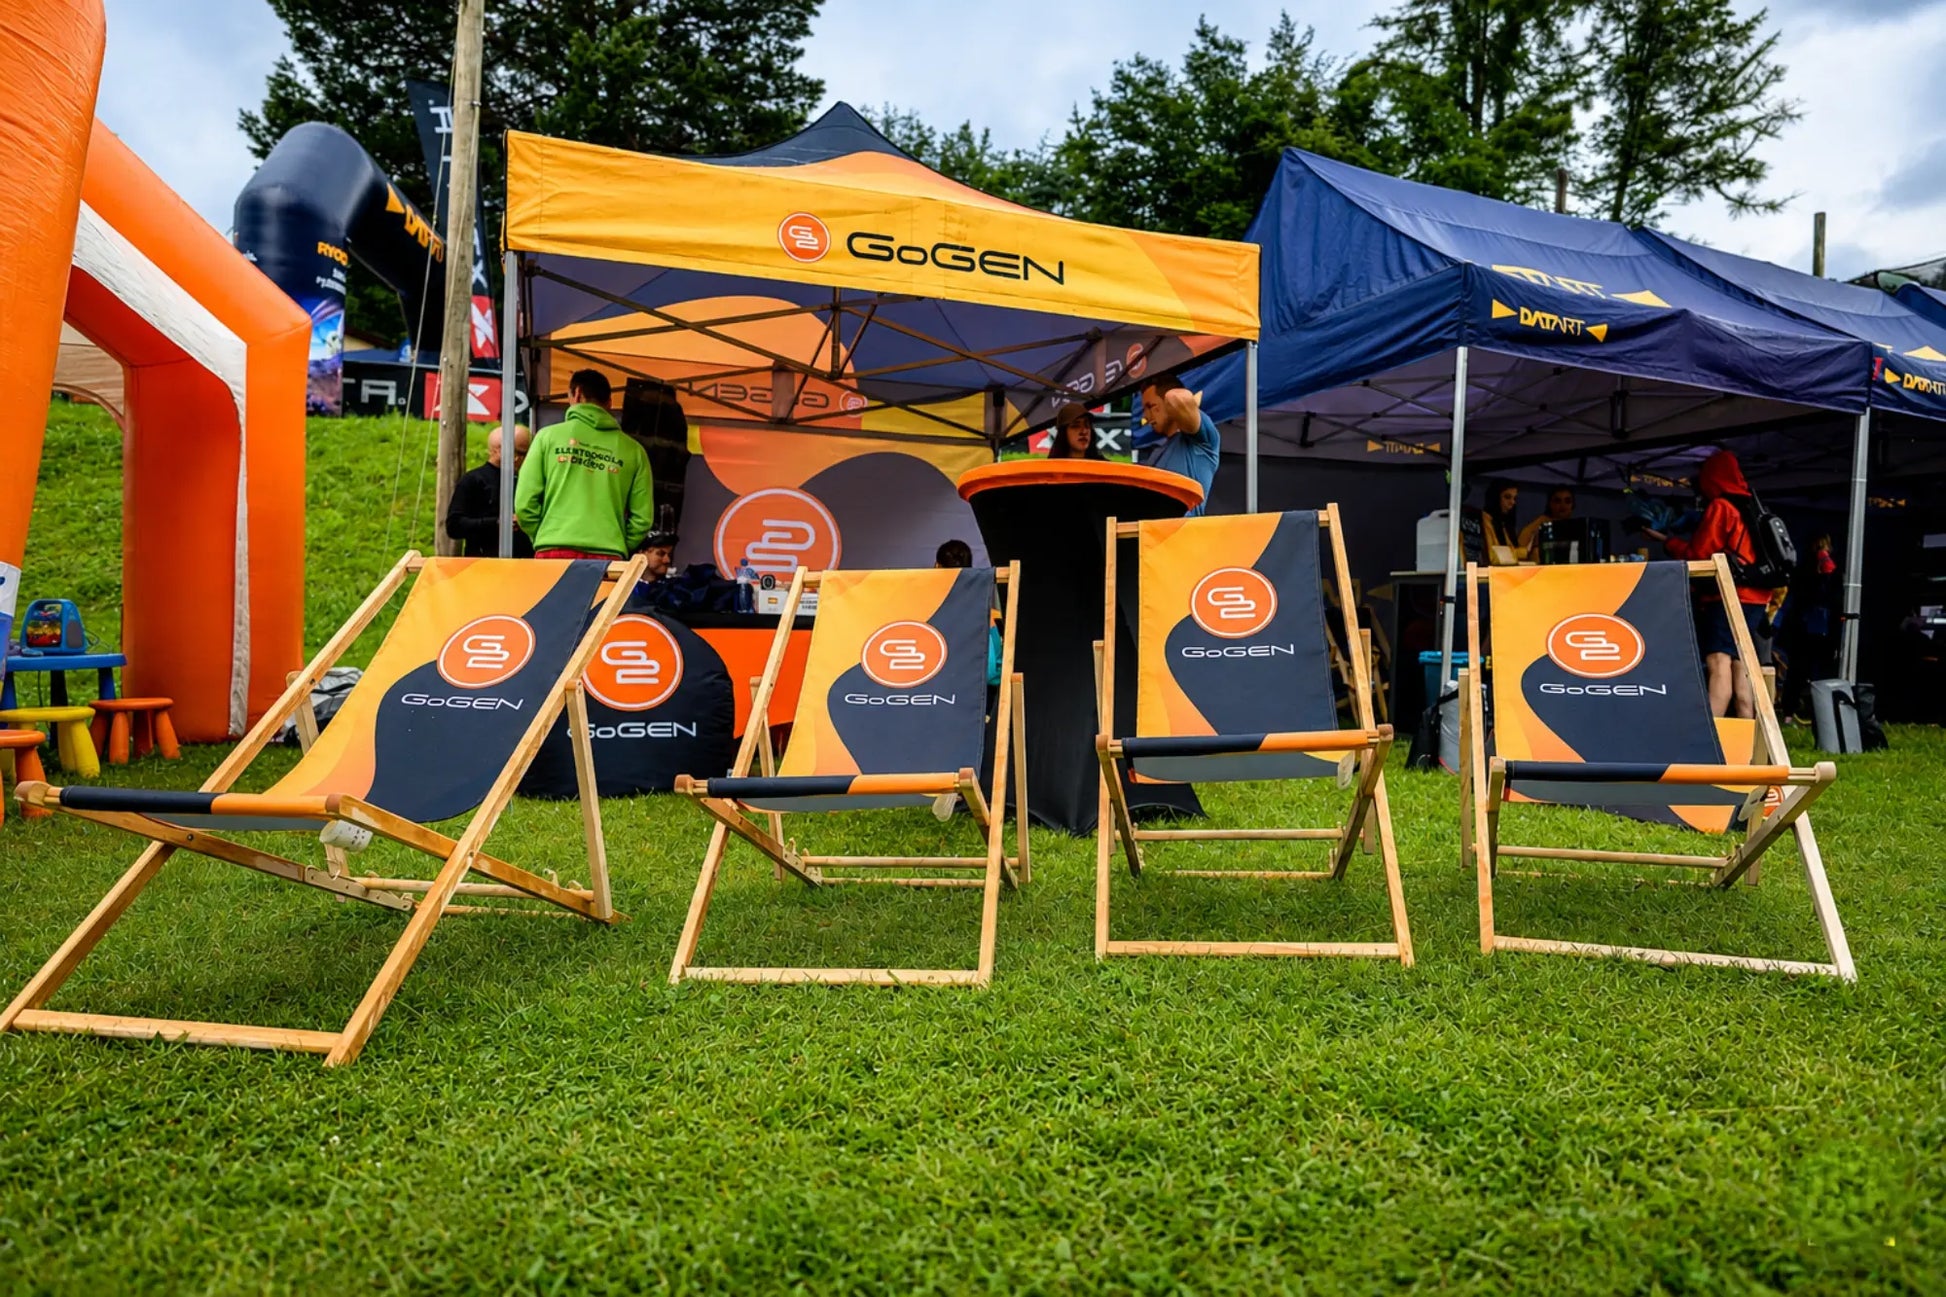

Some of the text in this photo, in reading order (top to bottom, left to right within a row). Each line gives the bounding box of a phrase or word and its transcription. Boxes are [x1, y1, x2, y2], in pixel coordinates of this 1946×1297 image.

[847, 231, 1065, 286] GoGEN
[1181, 643, 1295, 658] GoGEN
[1539, 683, 1667, 697] GoGEN
[400, 693, 524, 711] GoGEN
[844, 693, 956, 706] GoGEN
